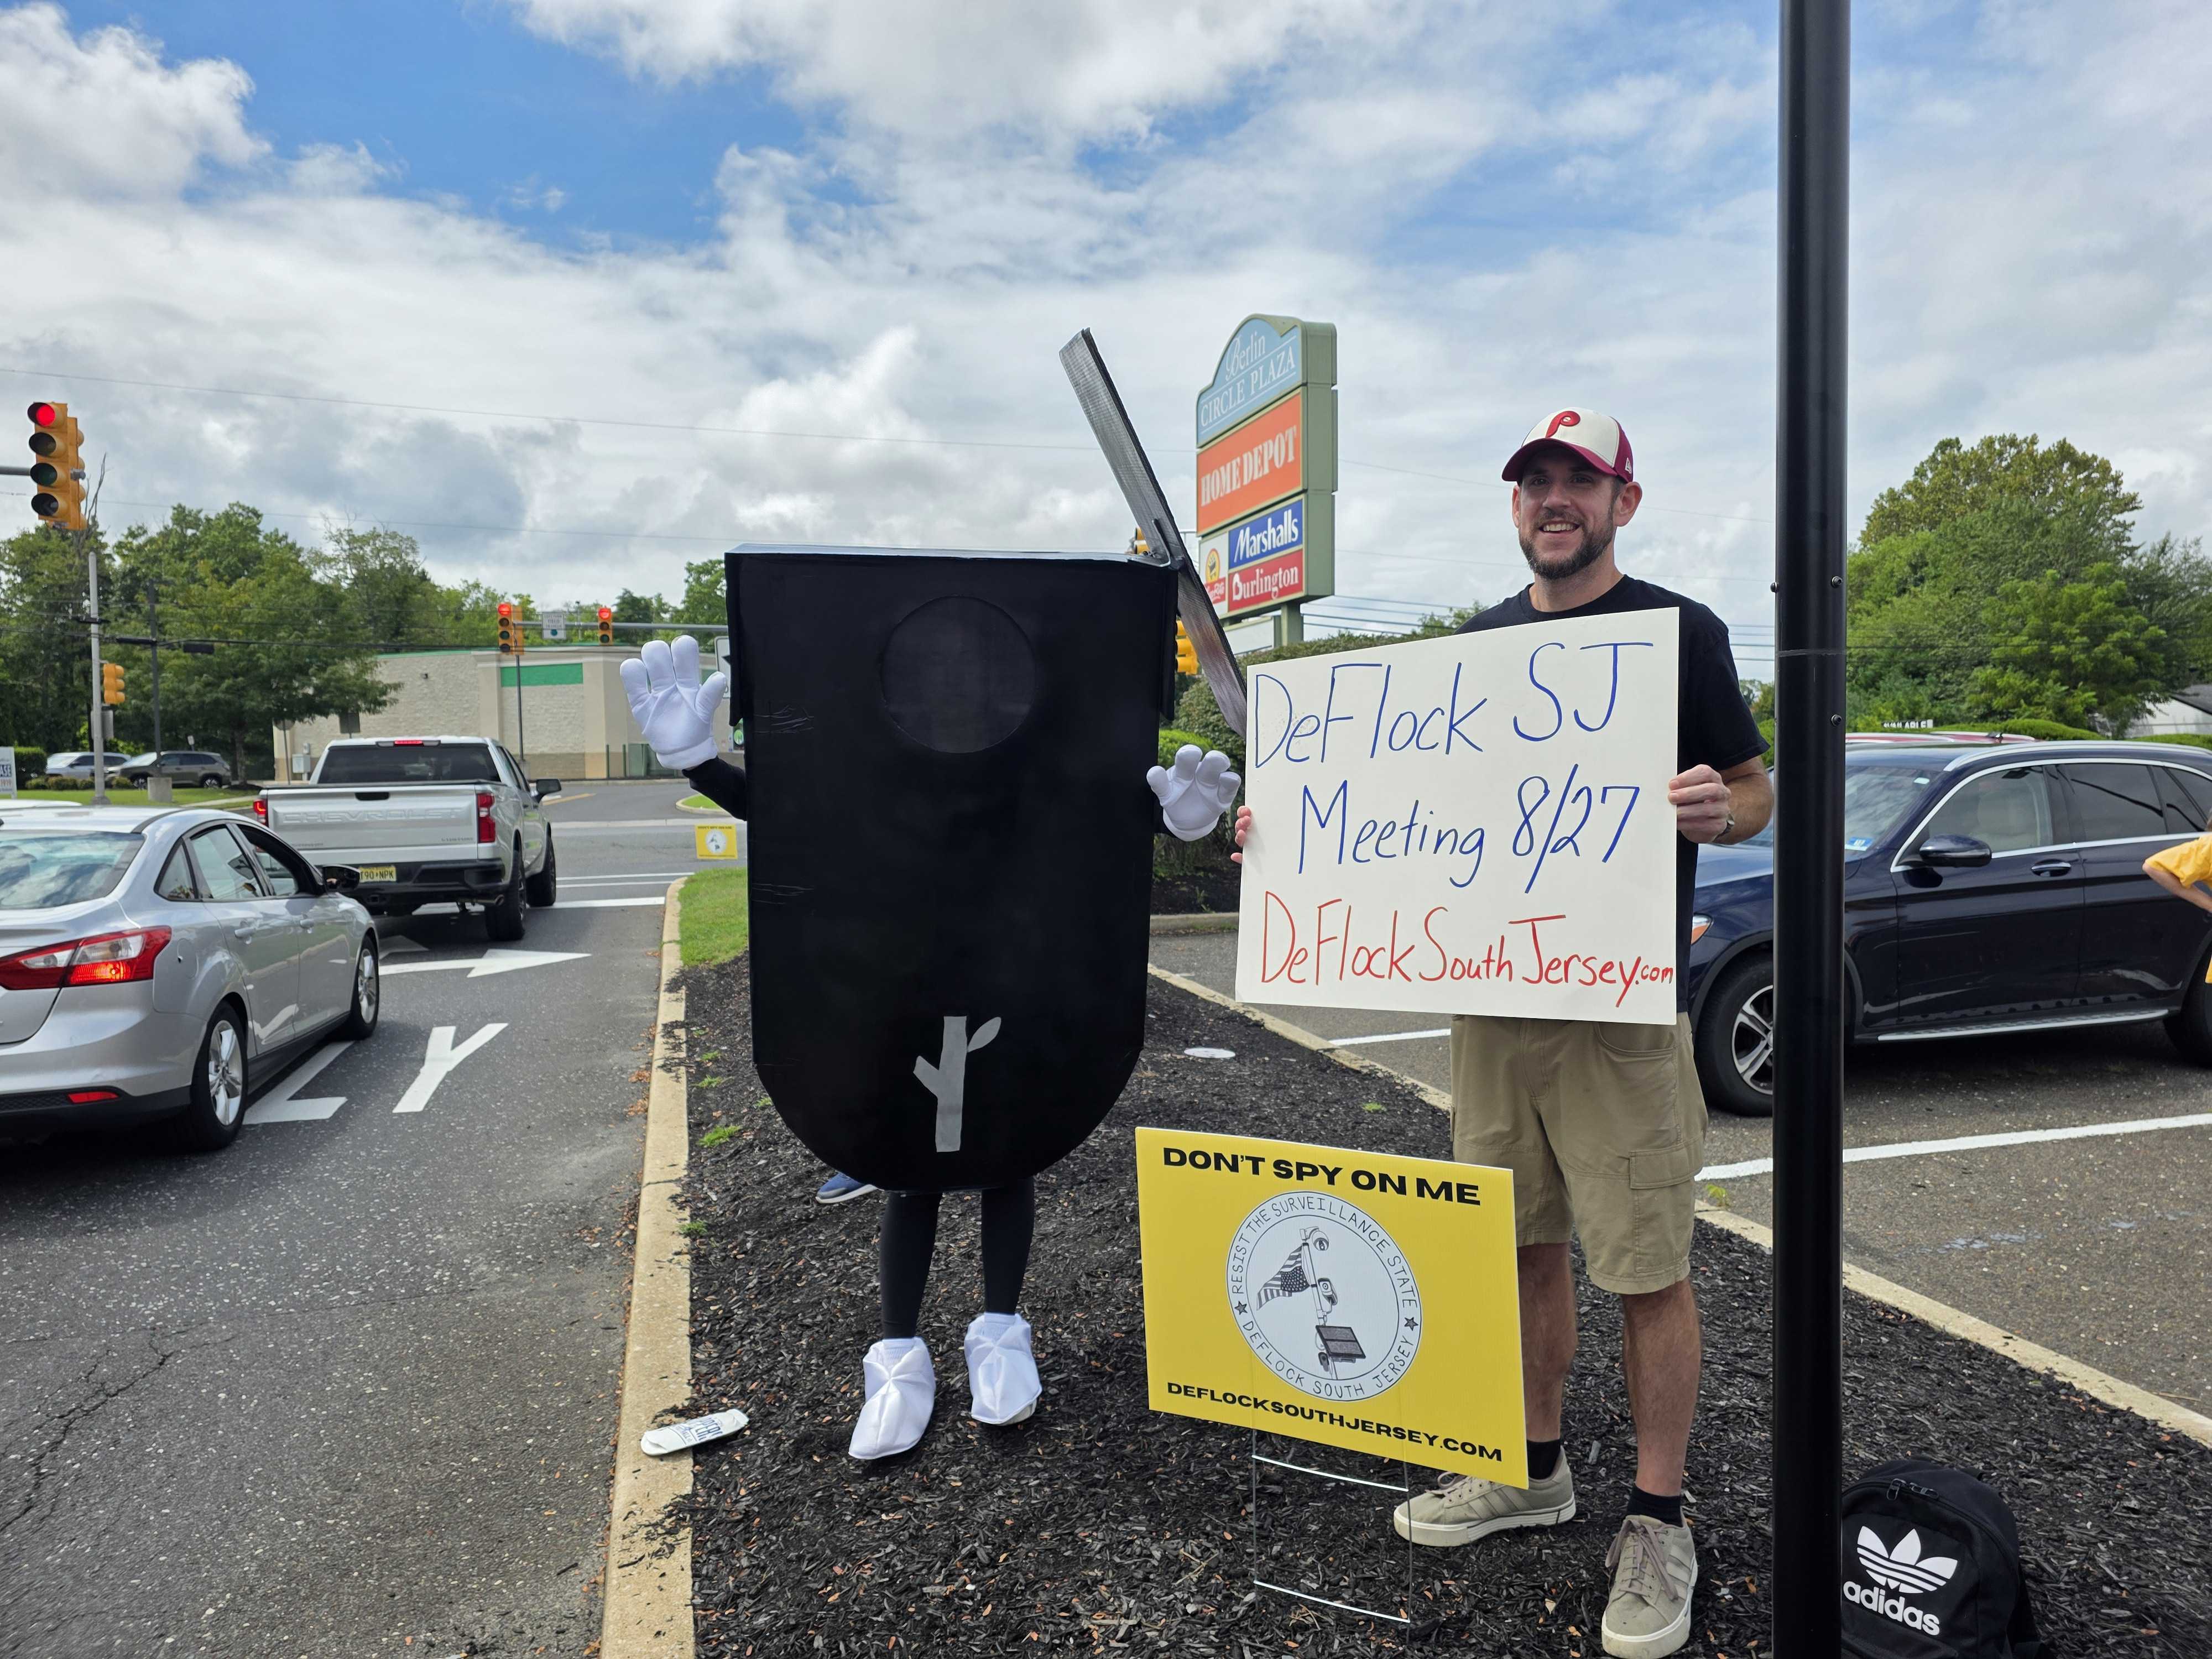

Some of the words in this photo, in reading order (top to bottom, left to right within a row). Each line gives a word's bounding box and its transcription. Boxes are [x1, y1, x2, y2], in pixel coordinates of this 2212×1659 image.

[1201, 379, 1245, 427] CIRCLE
[1250, 346, 1295, 395] PLAZA
[1225, 330, 1266, 381] Berlin
[1201, 456, 1241, 507] HOME
[1243, 425, 1297, 486] DEPOT
[1234, 509, 1298, 563] Marshalls
[1233, 566, 1299, 601] Burlington
[1255, 661, 1488, 768] DeFlock
[1513, 641, 1653, 742] SJ
[283, 807, 465, 823] CHEVROLET
[1298, 779, 1485, 888] Meeting
[1511, 764, 1641, 894] 8/27
[379, 870, 394, 879] NPK
[1163, 1147, 1266, 1176] DON'T
[1272, 1159, 1344, 1186] SPY
[1350, 1170, 1407, 1196] ON
[1416, 1177, 1481, 1206] ME
[1232, 1233, 1250, 1294] RESIST
[1246, 1209, 1271, 1234] THE
[1271, 1196, 1390, 1254] SURVEILLANCE
[1387, 1255, 1418, 1309] STATE
[1242, 1321, 1305, 1387] DEFLOCK
[1312, 1381, 1365, 1399] SOUTH
[1373, 1335, 1414, 1388] JERSEY
[1167, 1383, 1503, 1462] DEFLOCKSOUTHJERSEY.COM
[1843, 1580, 1940, 1636] adidas
